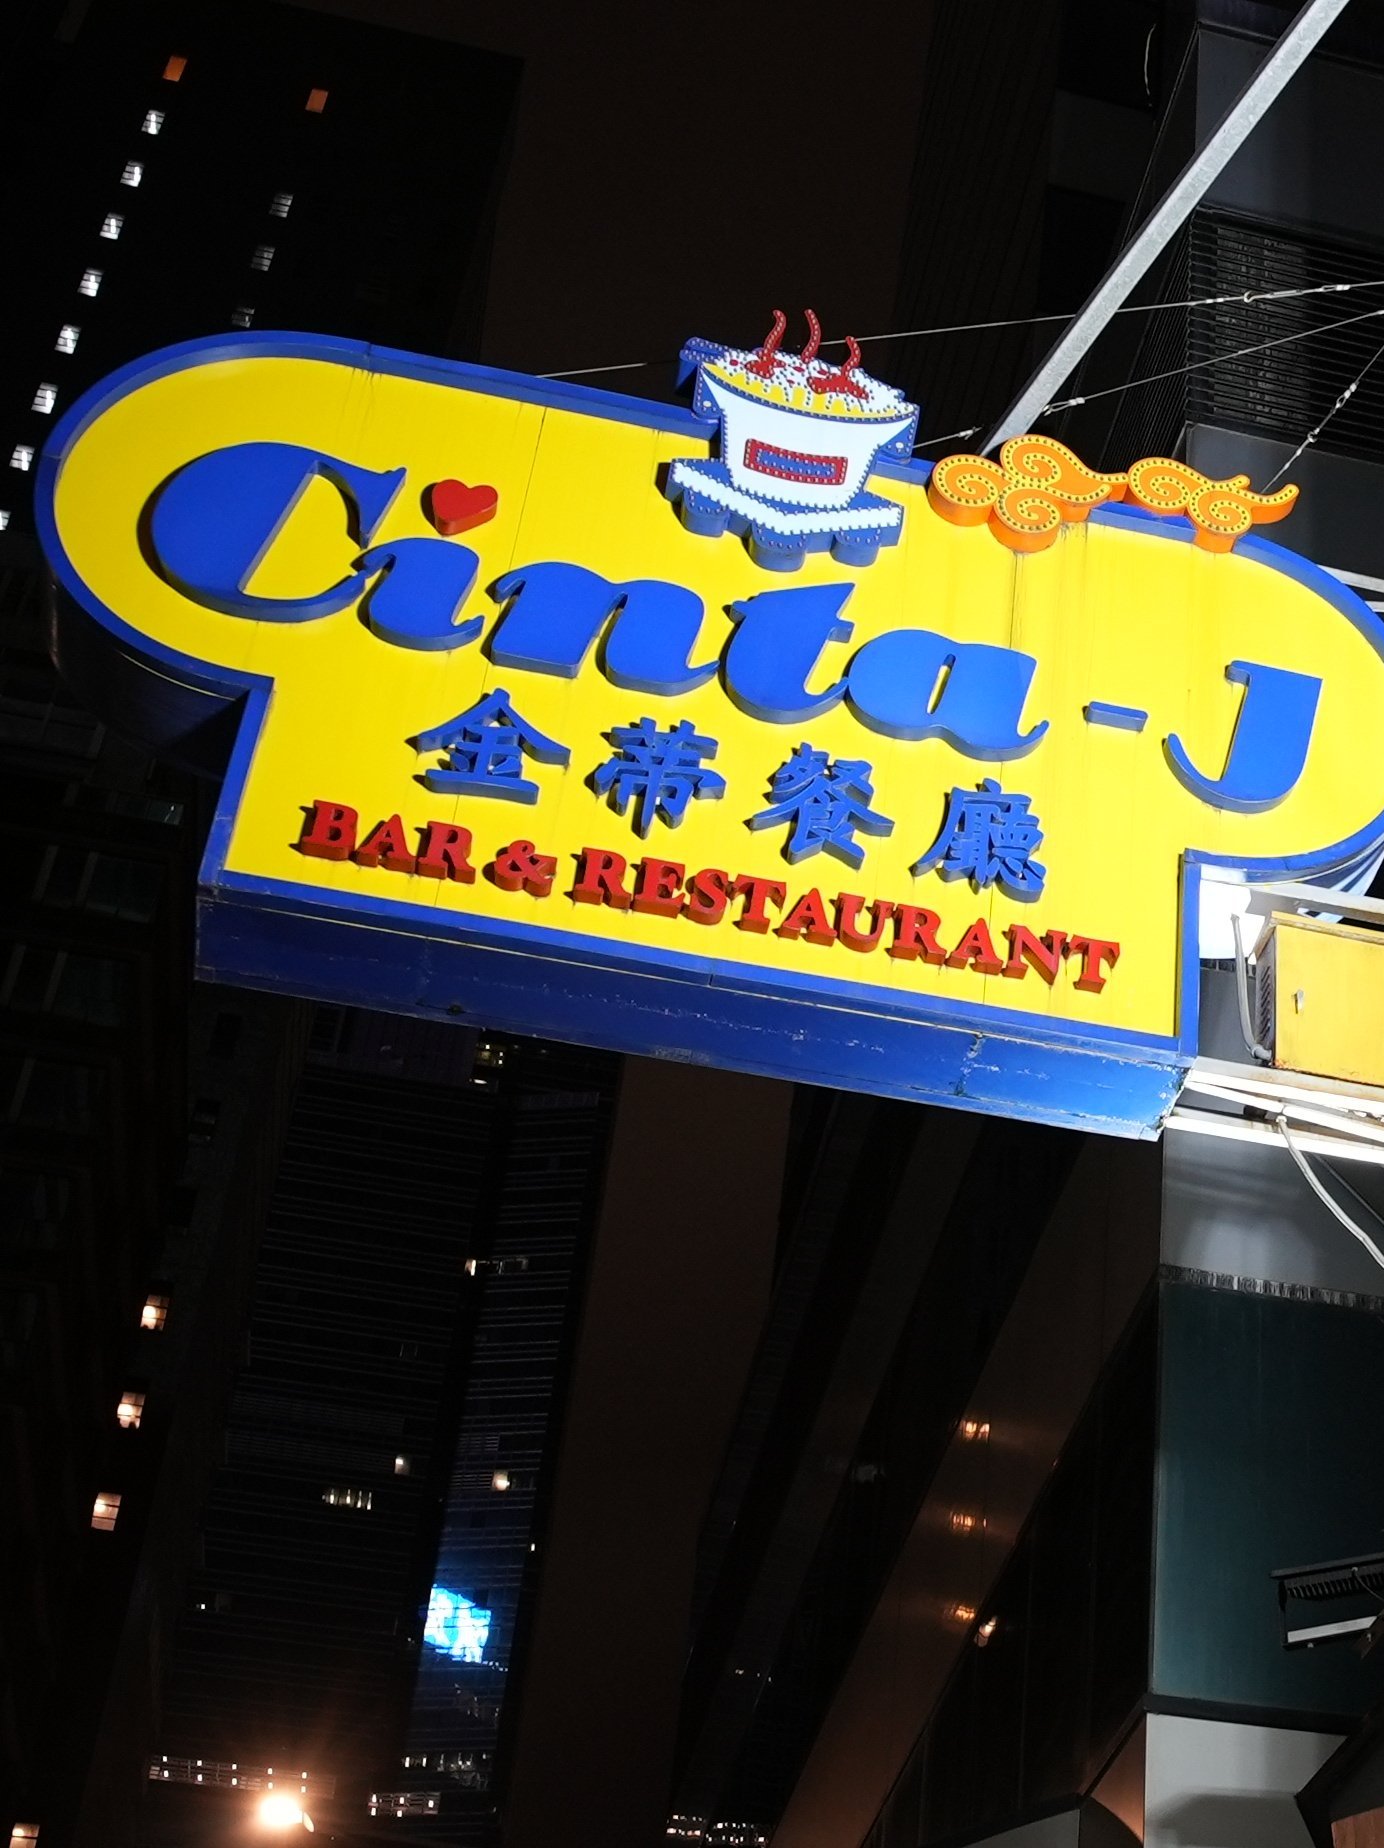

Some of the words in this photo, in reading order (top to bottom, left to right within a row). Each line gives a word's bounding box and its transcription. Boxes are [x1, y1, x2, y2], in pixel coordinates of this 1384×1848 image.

[141, 441, 1324, 812] Cinta-J
[300, 799, 476, 885] BAR
[493, 838, 558, 898] &
[572, 848, 1122, 993] RESTAURANT
[412, 686, 1050, 902] 金蒂餐廳
